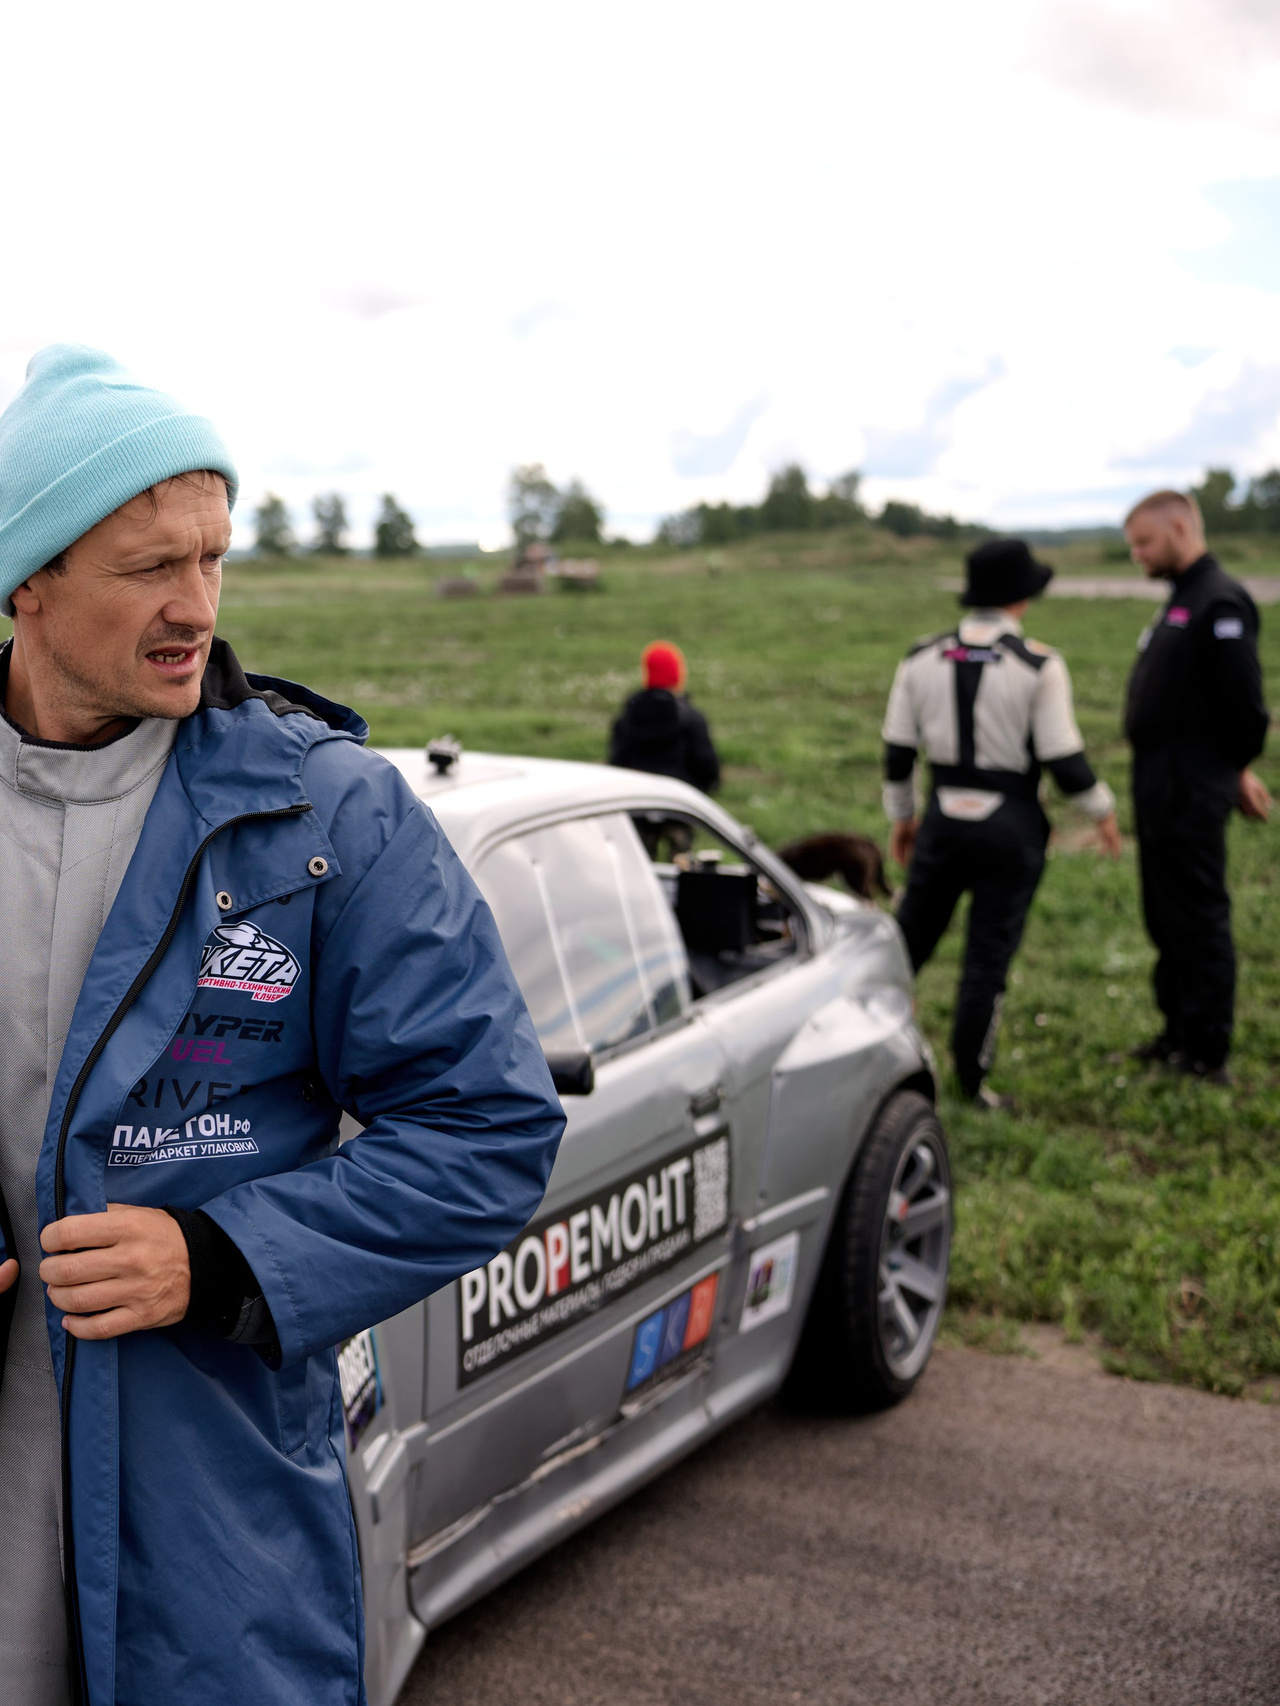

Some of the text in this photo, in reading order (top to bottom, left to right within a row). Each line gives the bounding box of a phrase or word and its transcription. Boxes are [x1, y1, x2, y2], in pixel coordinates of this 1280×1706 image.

[199, 946, 300, 986] КЕТА
[166, 1038, 232, 1065] UEL
[127, 1077, 256, 1111] RIVE
[200, 1141, 255, 1155] УПАКОВКИ
